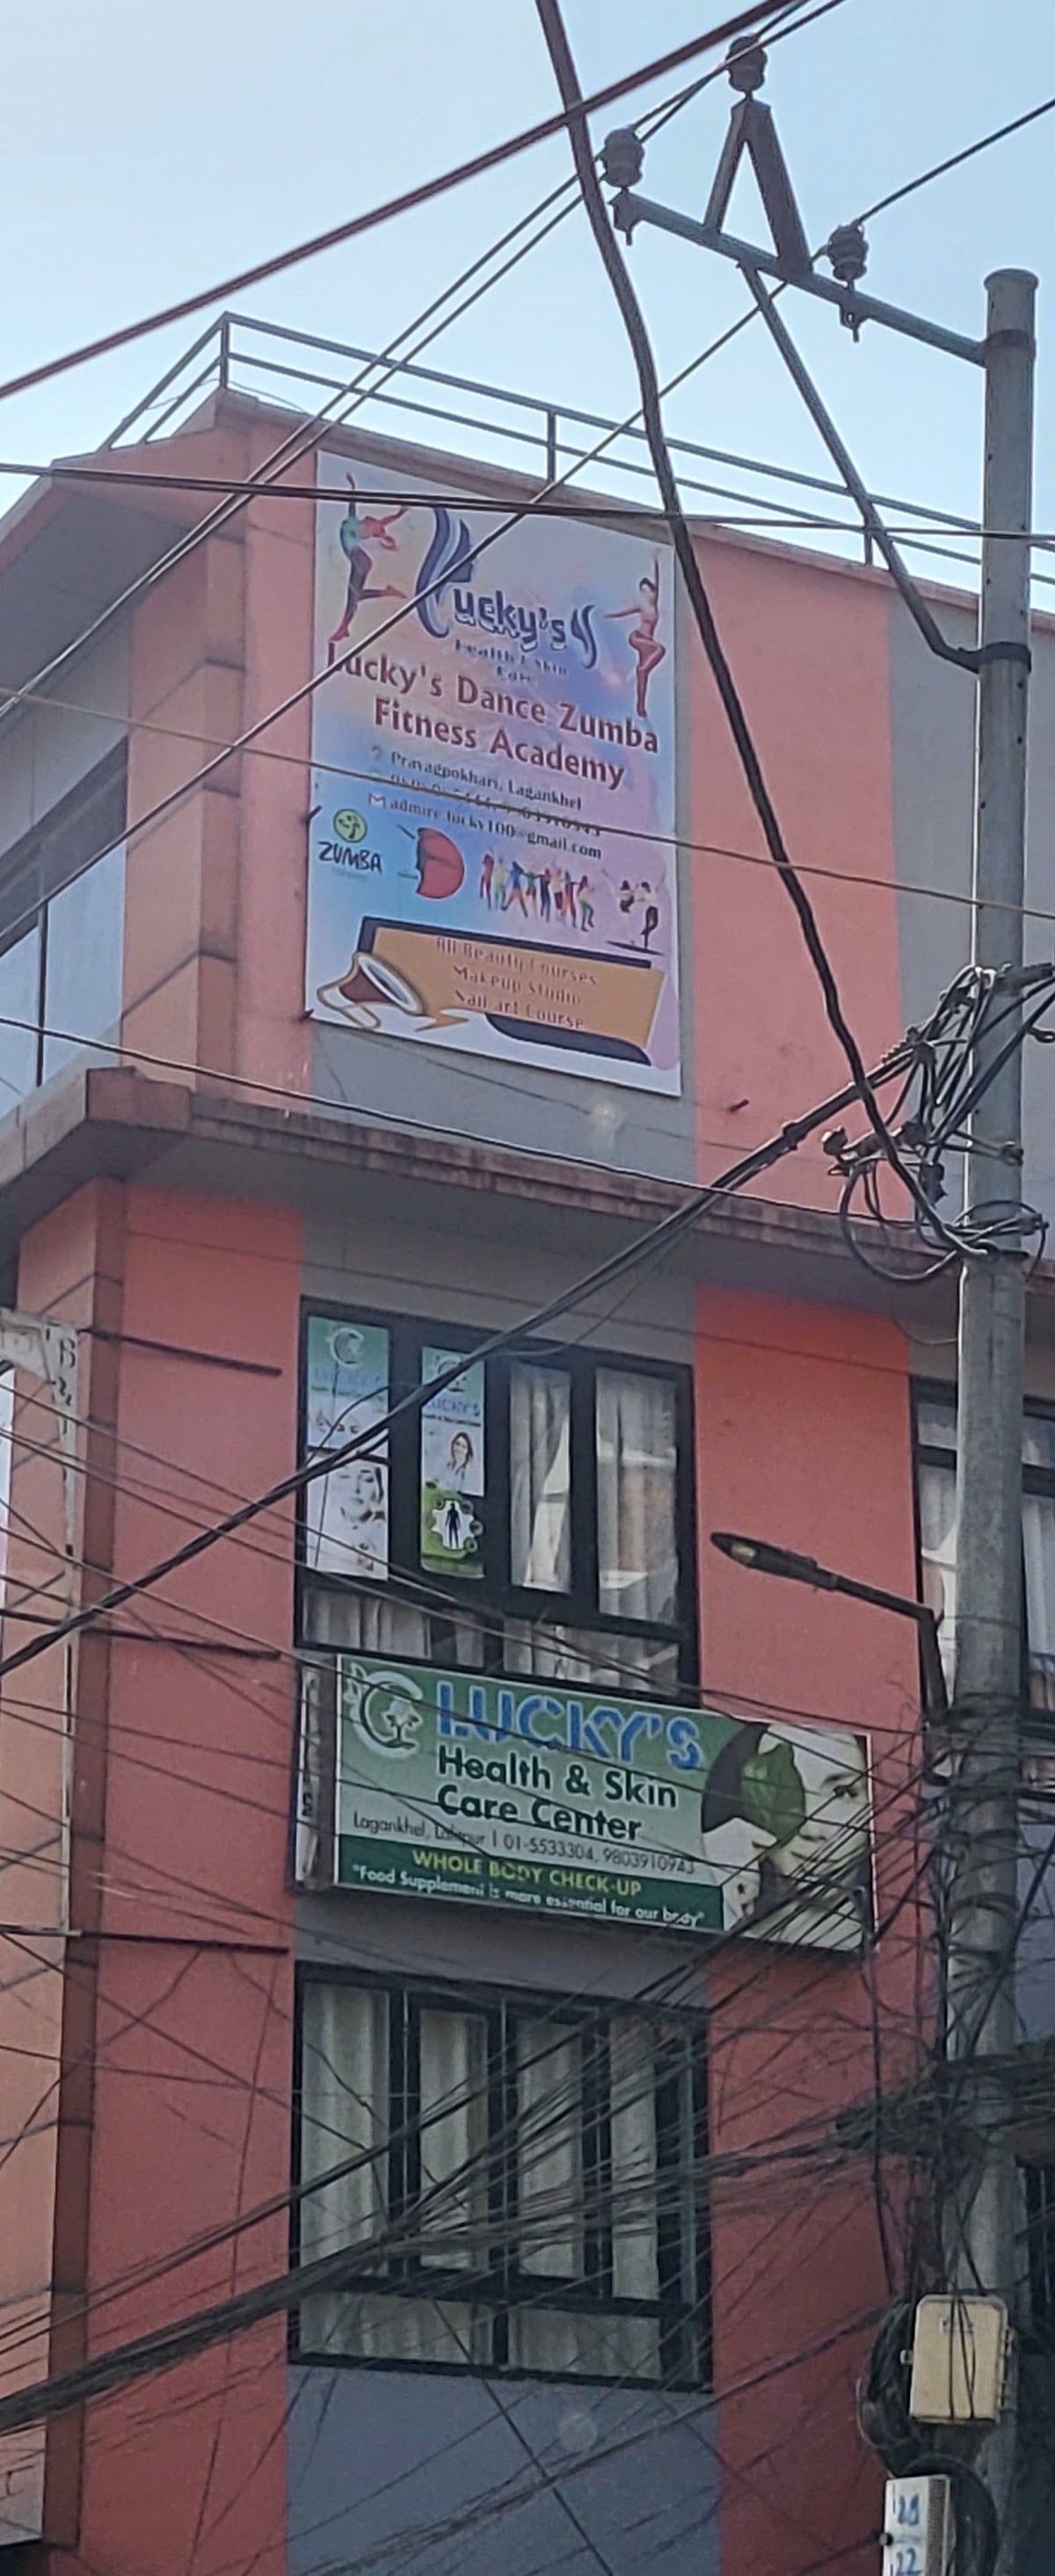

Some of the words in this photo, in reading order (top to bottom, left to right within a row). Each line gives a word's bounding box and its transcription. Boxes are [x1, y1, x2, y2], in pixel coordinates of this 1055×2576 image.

[328, 643, 442, 697] Lucky's
[458, 675, 546, 724] Dance
[559, 702, 658, 753] Zumba
[375, 697, 477, 748] Fitness
[490, 729, 625, 790] Academy
[317, 840, 382, 874] ZUMBA
[453, 965, 521, 993] Makeup
[463, 943, 523, 973] Beauty
[437, 1680, 702, 1771] LUCKY'S
[439, 1745, 551, 1790] Health
[566, 1764, 591, 1796] &
[605, 1769, 679, 1809] Skin
[353, 1811, 431, 1840] Lagankhel,
[438, 1785, 518, 1823] Care
[531, 1796, 643, 1841] Center
[400, 1870, 484, 1897] Supplement
[506, 1888, 542, 1904] more
[611, 1900, 630, 1917] for
[635, 1907, 658, 1920] our
[412, 1850, 483, 1875] WHOLE
[489, 1860, 542, 1883] BODY
[549, 1870, 643, 1897] CHECK-UP
